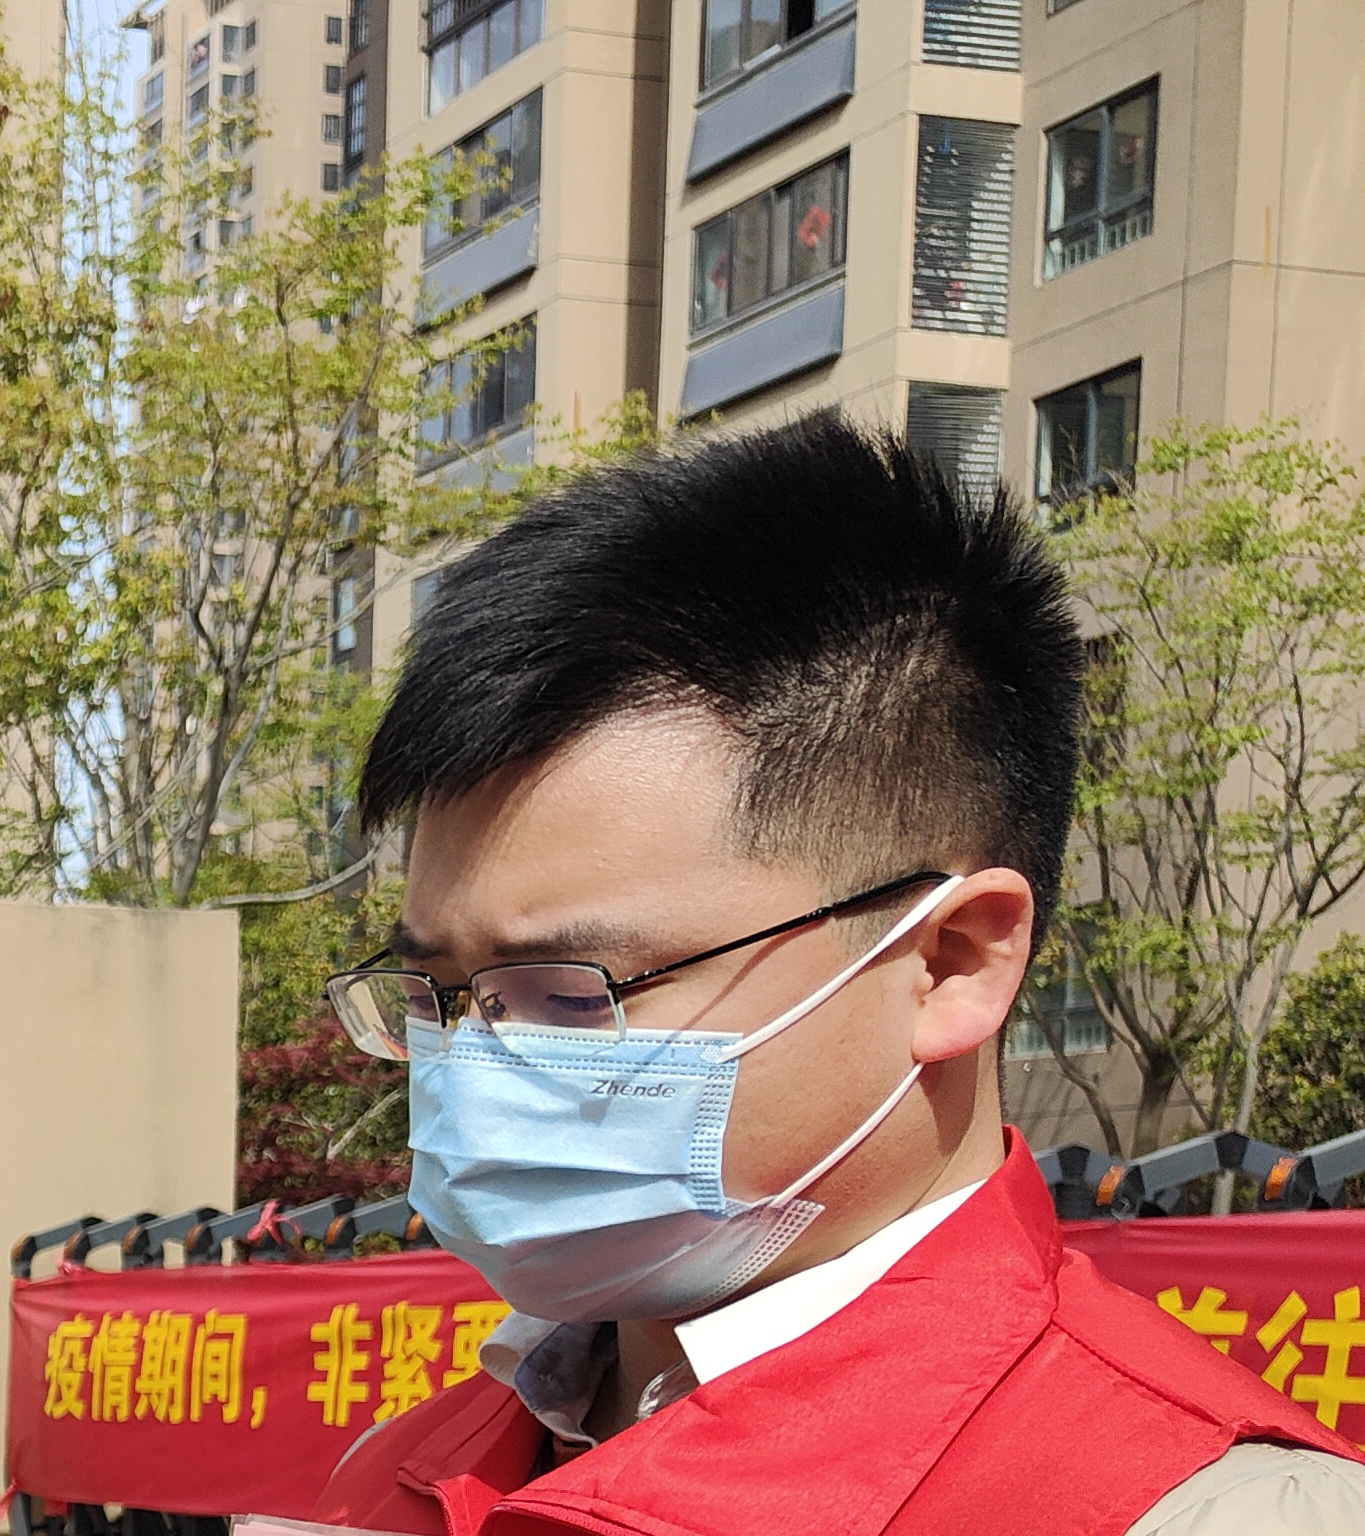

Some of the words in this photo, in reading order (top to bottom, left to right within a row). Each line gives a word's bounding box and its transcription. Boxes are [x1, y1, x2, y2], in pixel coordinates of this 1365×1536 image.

[590, 1079, 676, 1099] Zhende
[44, 1308, 268, 1430] 疫情期间，
[1157, 1284, 1365, 1440] 往
